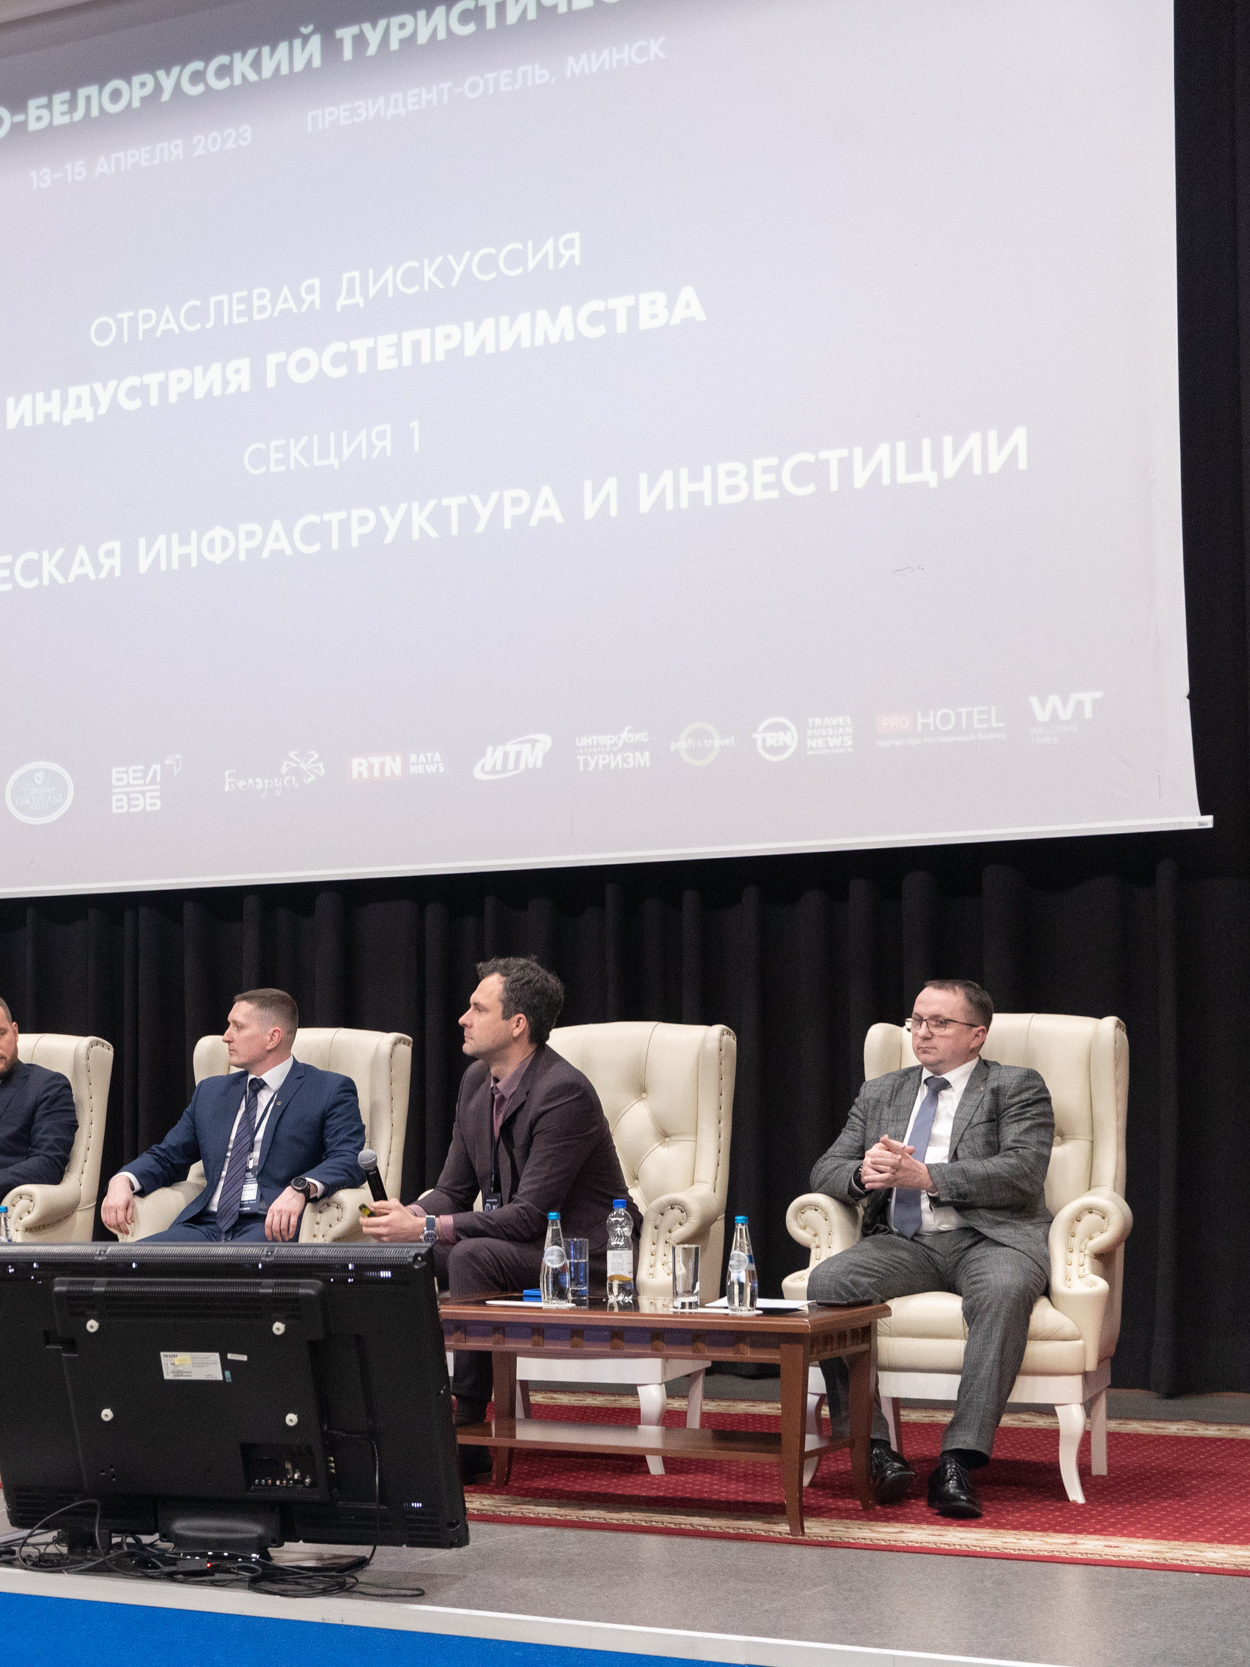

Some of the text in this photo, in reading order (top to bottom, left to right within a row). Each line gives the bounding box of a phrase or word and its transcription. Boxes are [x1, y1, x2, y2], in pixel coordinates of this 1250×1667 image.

[95, 139, 184, 177] АПРЕЛЯ
[193, 125, 252, 157] 2023
[306, 64, 556, 133] ПРЕЗИДЕНТ-ОТЕЛЬ,
[566, 36, 667, 78] МИНСК
[90, 231, 582, 347] ОТРАСЛЕВАЯ ДИСКУССИЯ
[6, 285, 707, 430] ИНДУСТРИЯ ГОСТЕПРИИМСТВА
[243, 420, 420, 475] СЕКЦИЯ 1
[138, 484, 565, 574] ИНФРАСТРУКТУРА
[584, 477, 618, 521] И
[638, 425, 1029, 514] ИНВЕСТИЦИИ
[806, 715, 853, 727] TRAVEL
[881, 705, 1006, 732] PRO HOTEL
[751, 731, 794, 748] TRN
[806, 725, 854, 737] RUSSIAN
[806, 736, 853, 750] NEWS
[351, 754, 403, 780] RTN
[409, 751, 443, 764] RATA
[409, 763, 446, 775] NEWS
[576, 750, 651, 772] ТУРИЗМ
[112, 764, 162, 786] БЕЛ
[112, 789, 162, 814] ВЭБ
